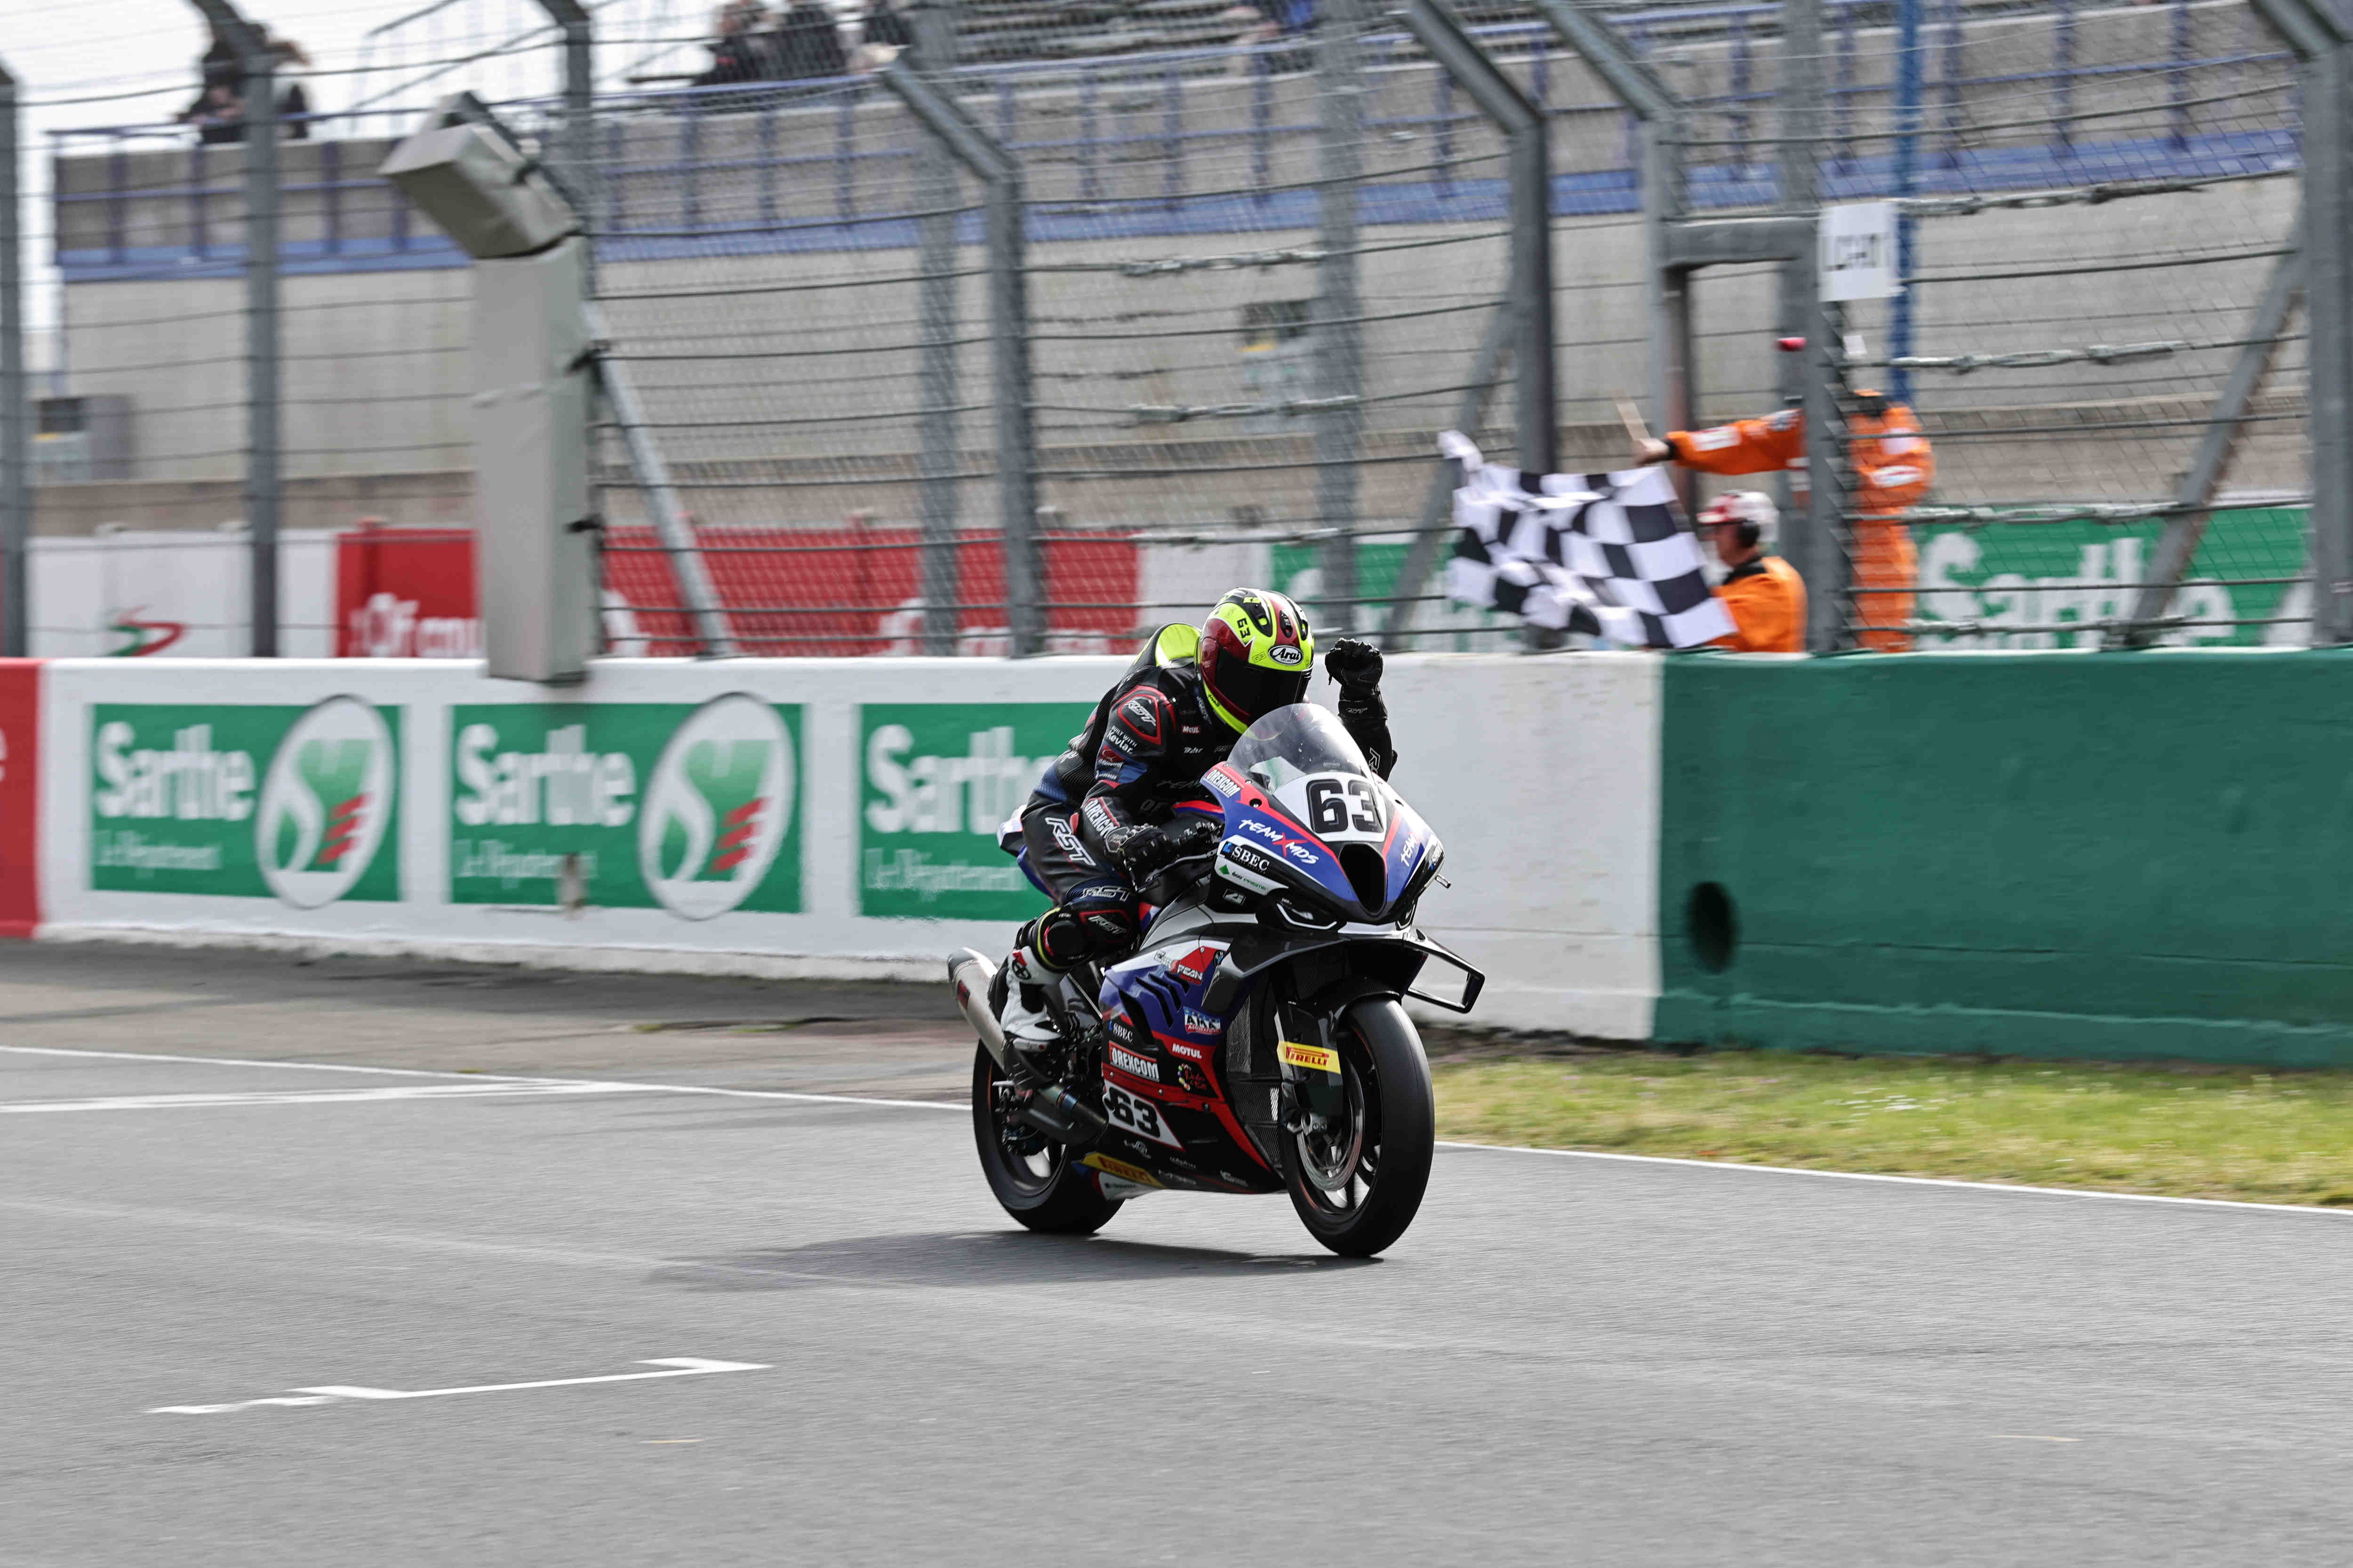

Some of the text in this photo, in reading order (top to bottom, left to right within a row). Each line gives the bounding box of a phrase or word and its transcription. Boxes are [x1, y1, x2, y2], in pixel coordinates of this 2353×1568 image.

[1237, 618, 1251, 639] 63
[1273, 648, 1300, 660] Arai
[1111, 725, 1124, 737] BUILT
[96, 721, 255, 821] Sarthe
[455, 723, 635, 827] Sarthe
[1207, 768, 1241, 797] OREXCOM
[1306, 779, 1385, 833] 63
[1045, 817, 1096, 866] RST
[1285, 842, 1319, 864] MDS
[1232, 846, 1270, 871] SBEC
[1112, 1047, 1160, 1080] OREXCOM
[1172, 1043, 1202, 1059] MOTUL
[1286, 1046, 1329, 1066] PIRELLI
[1104, 1087, 1160, 1138] 63
